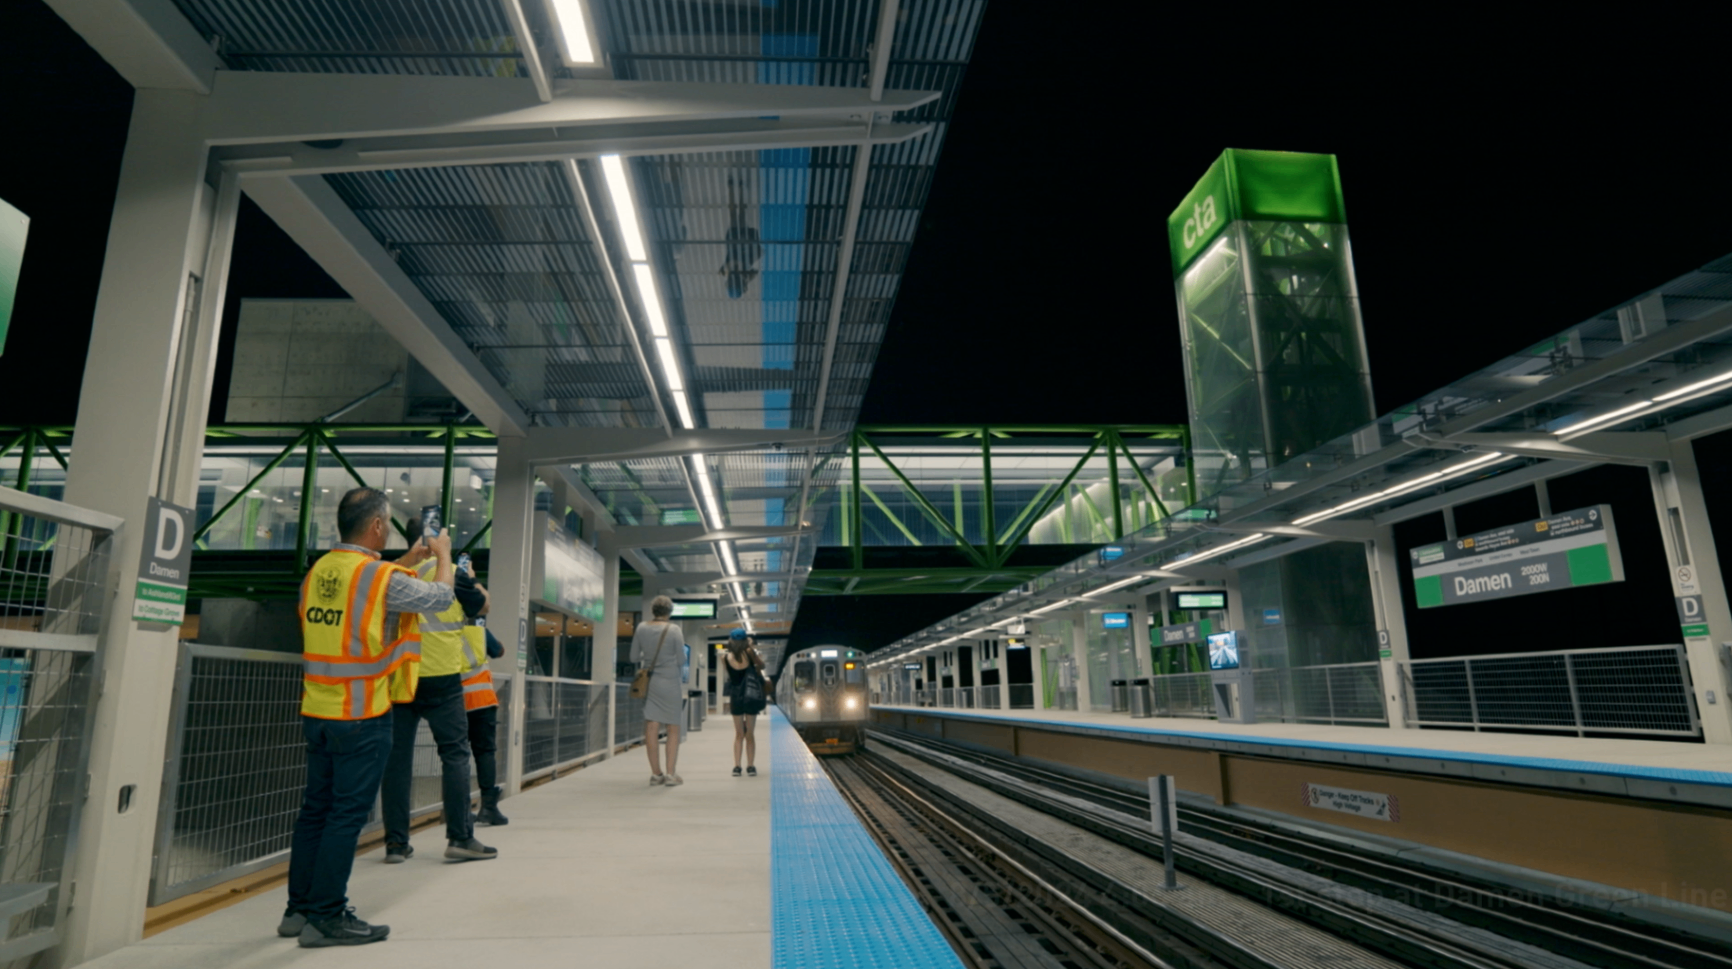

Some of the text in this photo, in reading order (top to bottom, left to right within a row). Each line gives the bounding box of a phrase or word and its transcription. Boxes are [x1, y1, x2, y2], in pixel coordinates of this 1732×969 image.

[1183, 194, 1217, 249] cta
[154, 507, 185, 560] D
[149, 562, 181, 579] Damen
[1454, 562, 1548, 596] Damen 2000W
[1529, 572, 1550, 585] 200N
[306, 606, 344, 627] CDOT
[1681, 598, 1699, 617] D
[1164, 629, 1184, 642] Damen
[1379, 631, 1388, 645] D
